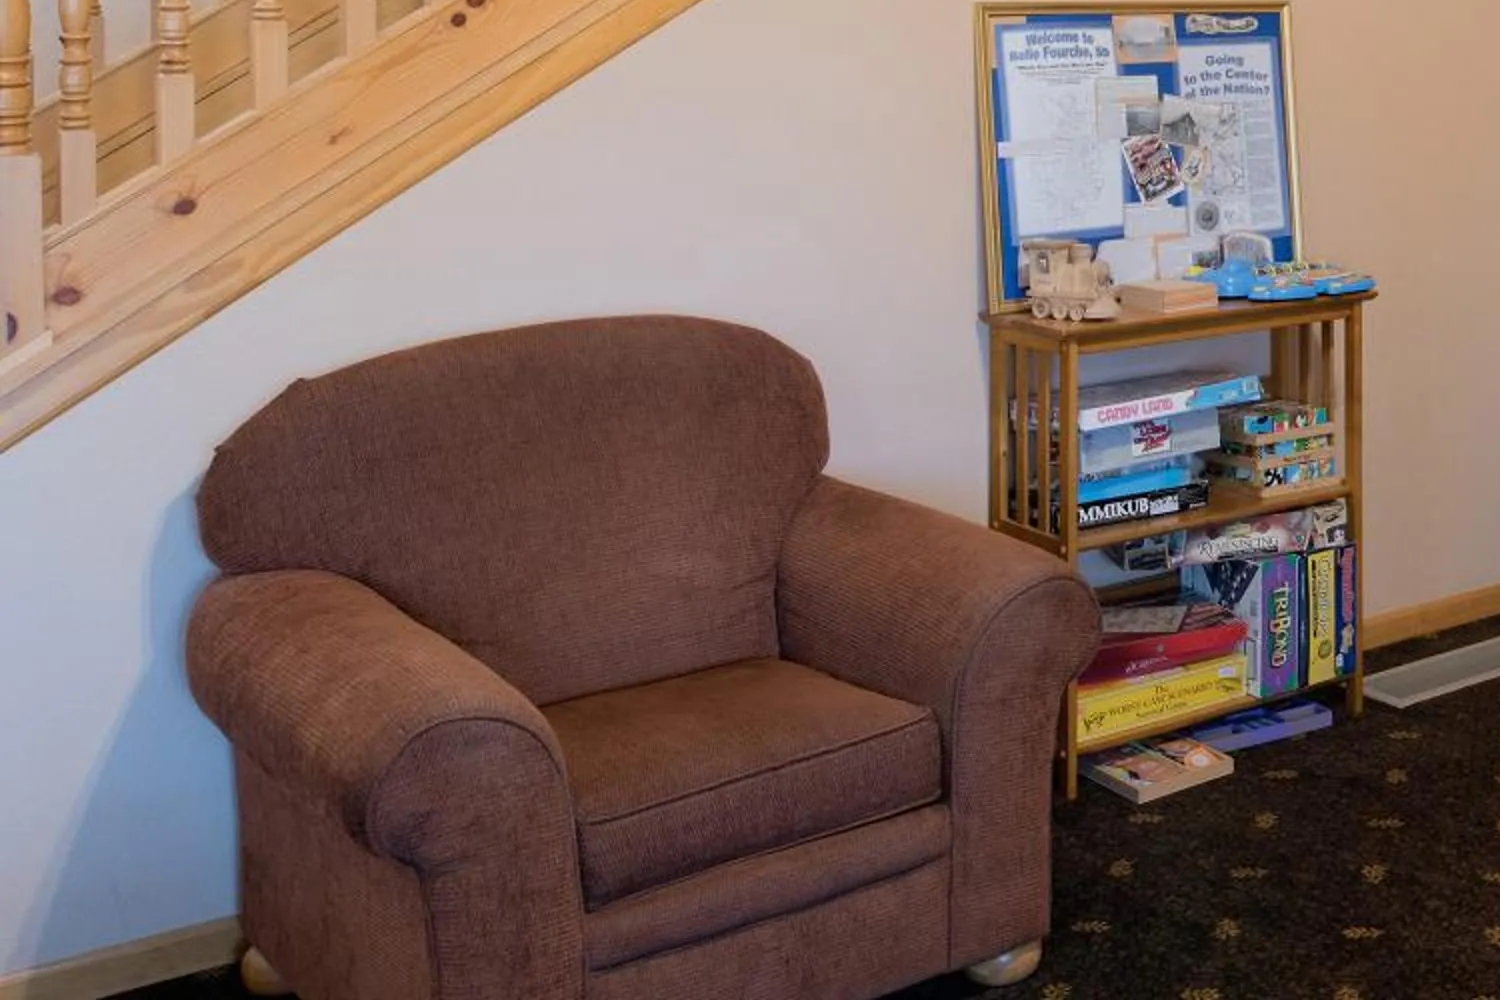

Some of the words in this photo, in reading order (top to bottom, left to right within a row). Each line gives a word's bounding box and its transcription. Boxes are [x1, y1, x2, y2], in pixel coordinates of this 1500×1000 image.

[1026, 32, 1079, 46] Welcome
[1081, 31, 1094, 44] to
[1205, 54, 1244, 67] Going
[1184, 74, 1197, 85] to
[1200, 70, 1222, 81] the
[1225, 69, 1268, 81] Center
[1200, 86, 1220, 96] the
[1223, 83, 1270, 96] Nation?
[1097, 405, 1139, 423] CANDY
[1142, 398, 1174, 414] LAND
[1078, 497, 1149, 523] MMIKUB
[1268, 581, 1292, 668] TRIBOND
